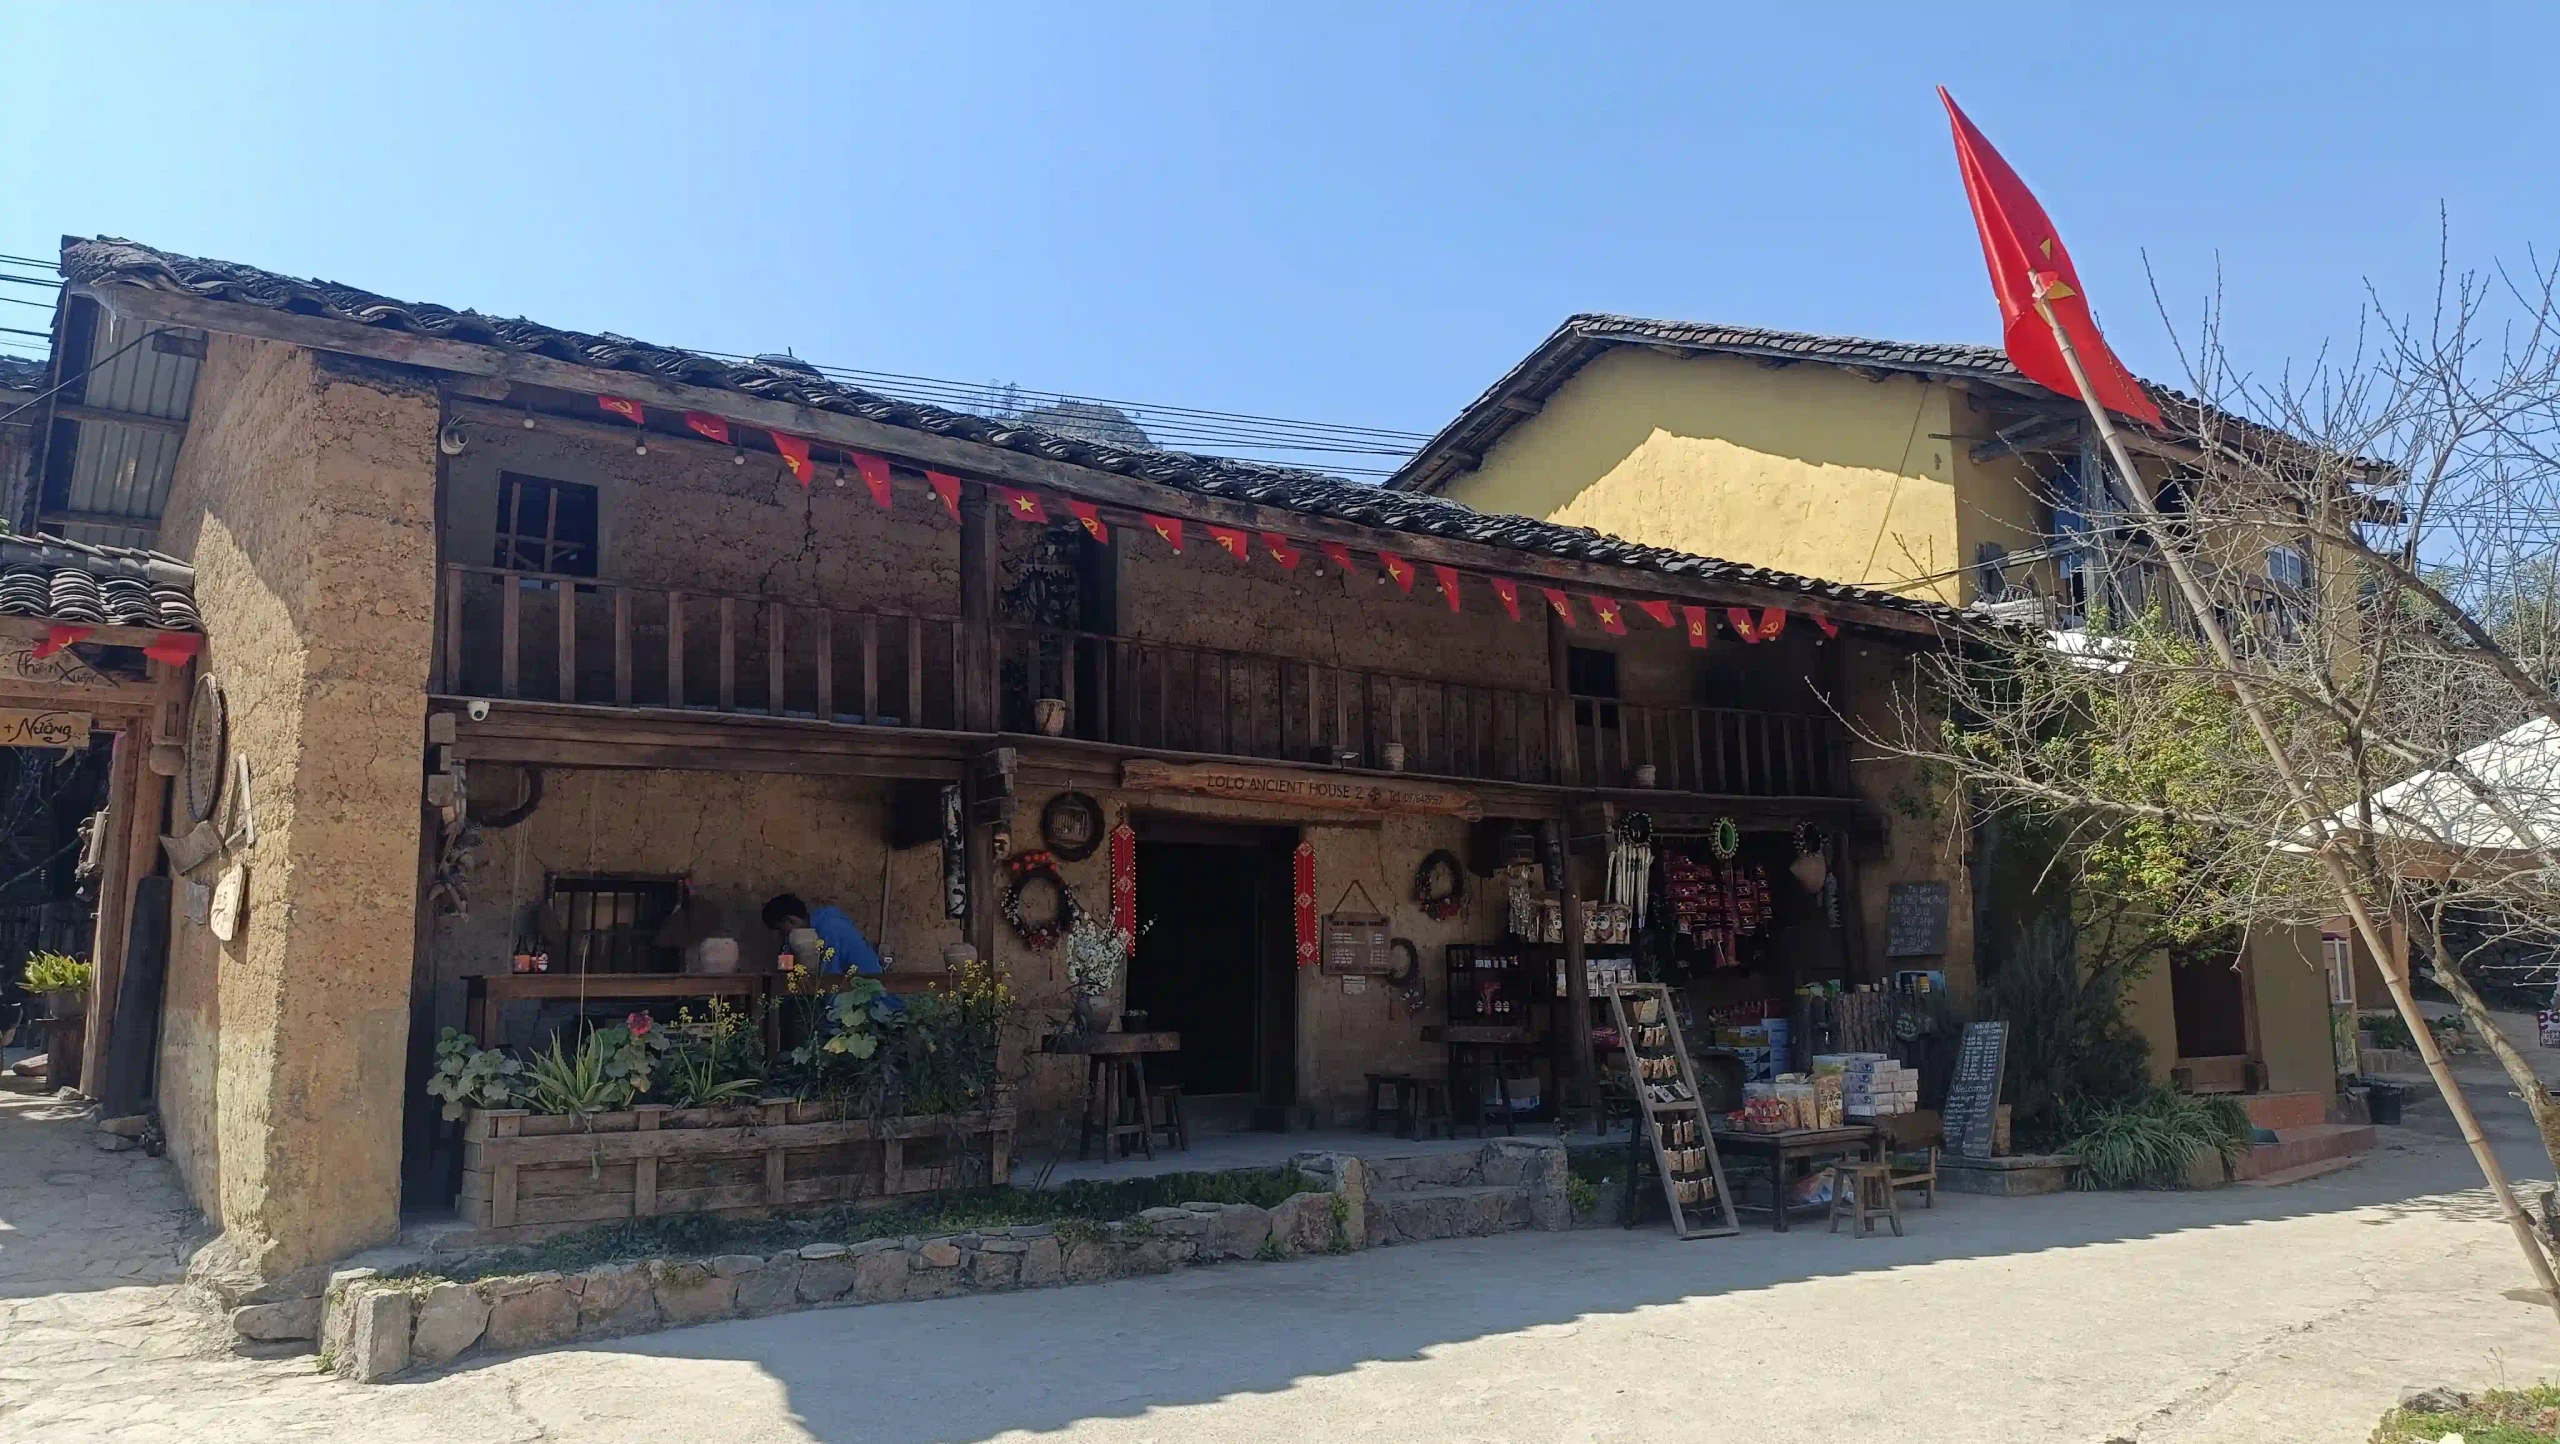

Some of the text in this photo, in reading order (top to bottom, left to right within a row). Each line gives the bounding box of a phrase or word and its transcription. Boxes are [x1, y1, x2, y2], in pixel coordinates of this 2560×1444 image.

[1207, 771, 1245, 790] LOLO
[1249, 777, 1304, 795] ANCIENT
[1309, 781, 1351, 799] HOUSE
[1355, 785, 1364, 800] 2
